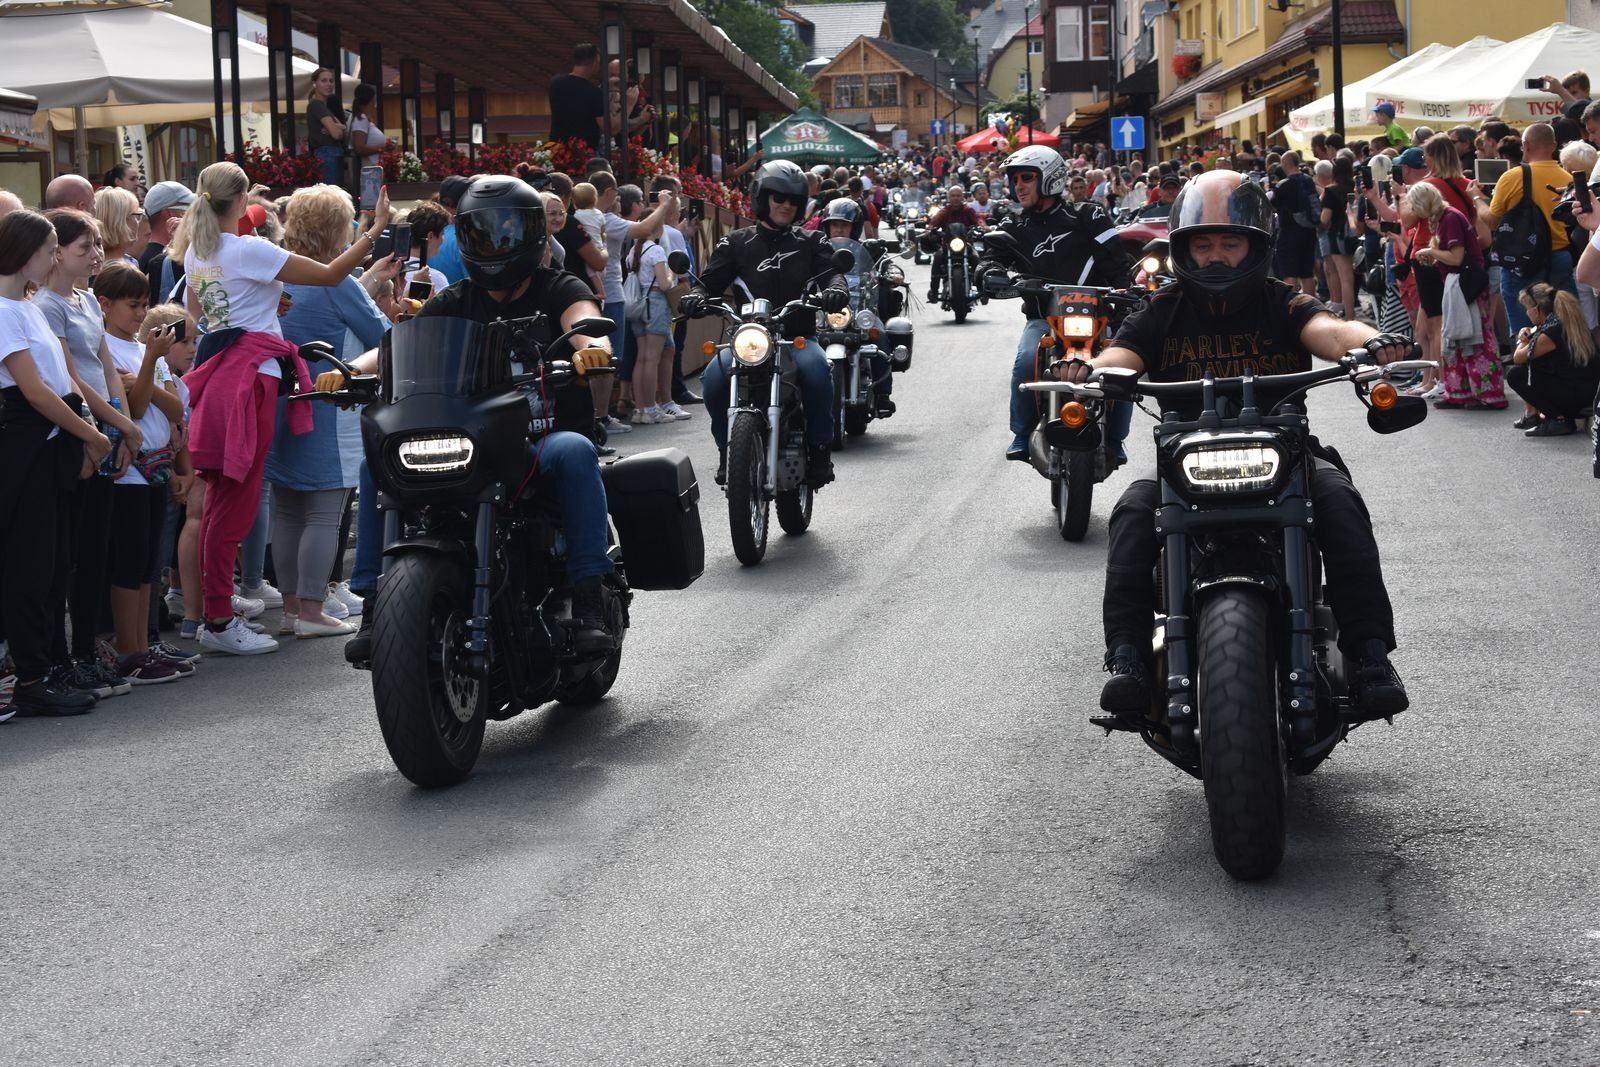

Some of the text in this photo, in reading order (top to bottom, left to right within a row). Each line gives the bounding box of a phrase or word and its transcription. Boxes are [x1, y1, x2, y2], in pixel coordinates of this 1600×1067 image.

[1420, 103, 1451, 118] VERDE
[1527, 101, 1564, 116] TYSK
[771, 142, 845, 154] ROHOZEC
[1058, 292, 1098, 306] KTM
[1160, 331, 1273, 371] HARLEY-
